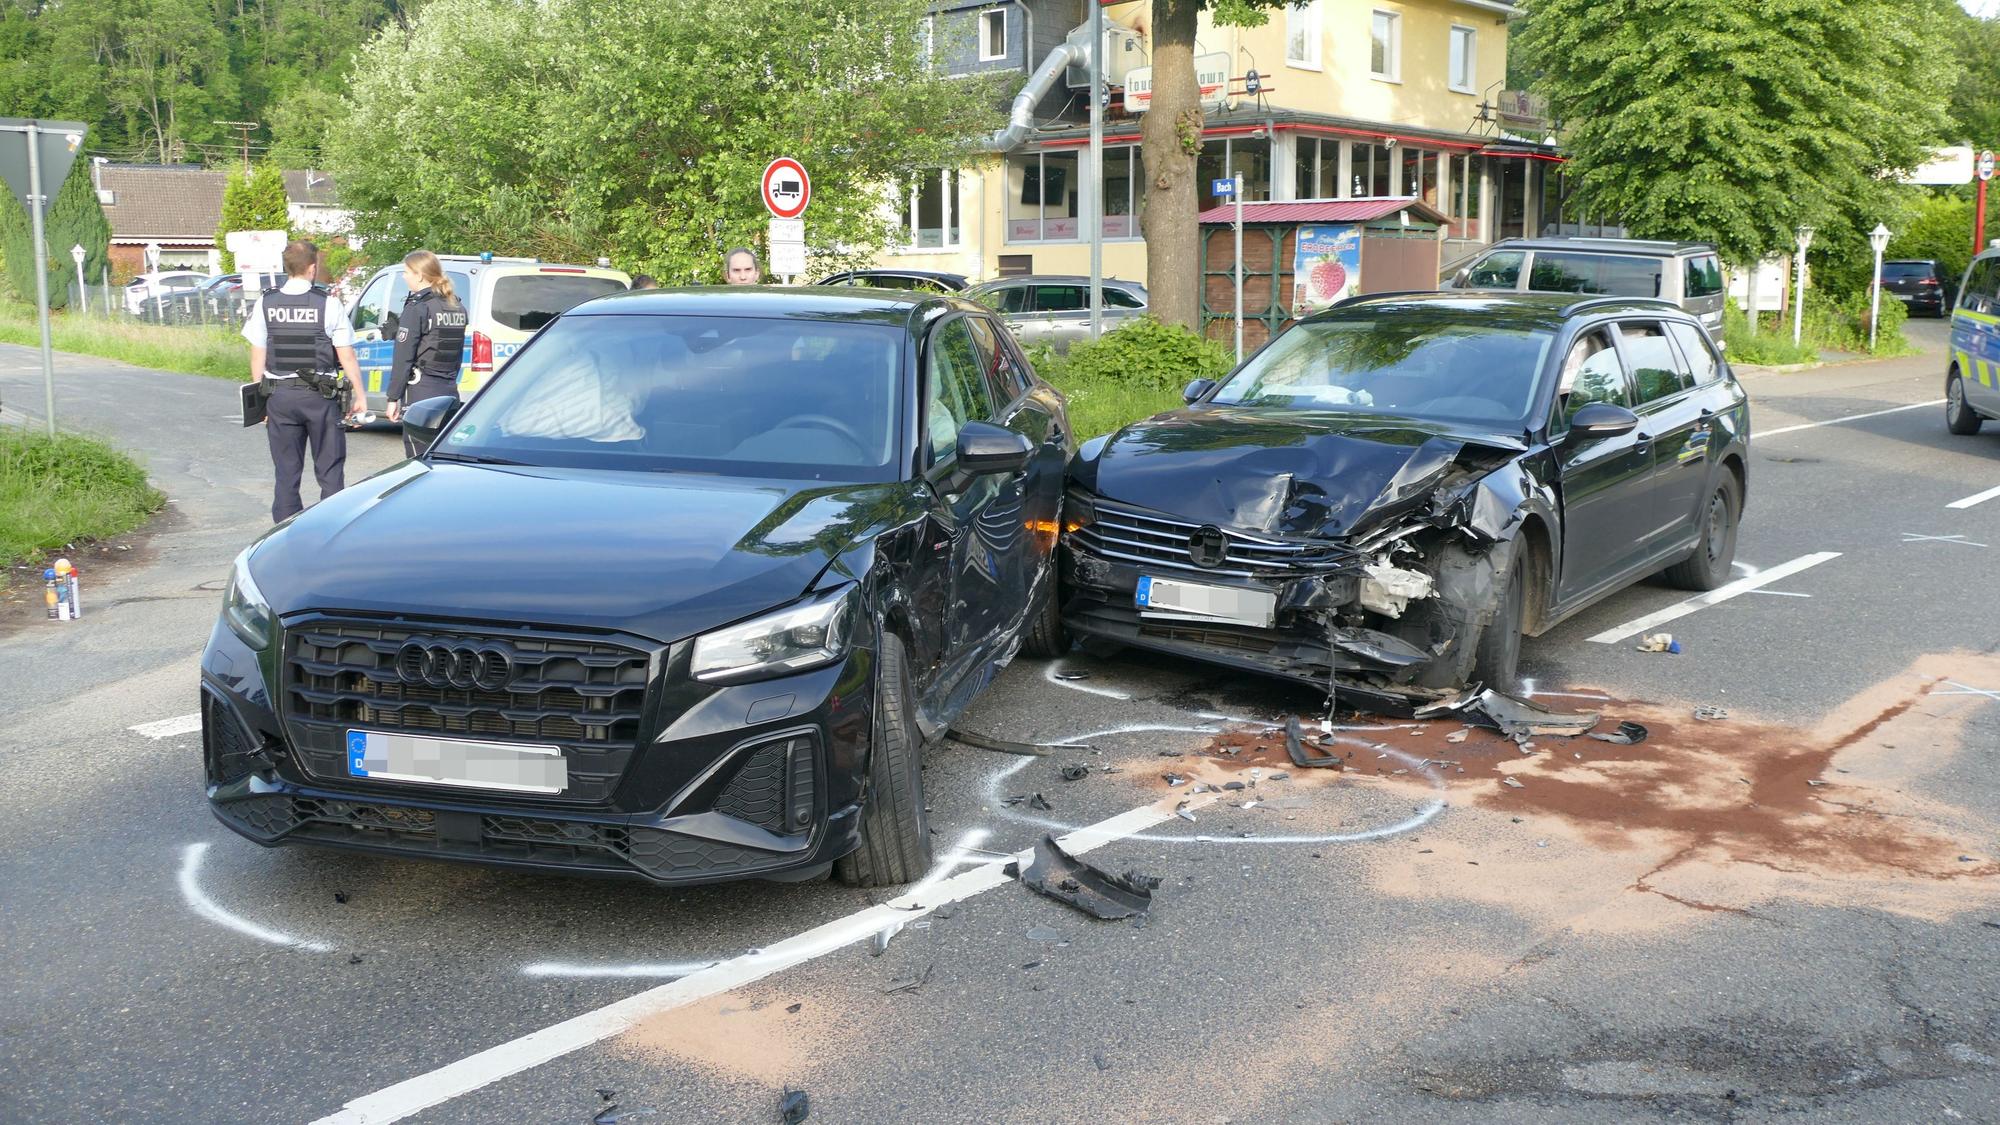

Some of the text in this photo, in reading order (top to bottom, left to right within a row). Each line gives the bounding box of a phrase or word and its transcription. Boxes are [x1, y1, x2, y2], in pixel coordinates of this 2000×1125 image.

[1129, 77, 1152, 92] touc
[1216, 181, 1232, 193] Bach
[267, 307, 319, 323] POLIZEI
[494, 344, 520, 357] PO
[355, 758, 363, 768] D
